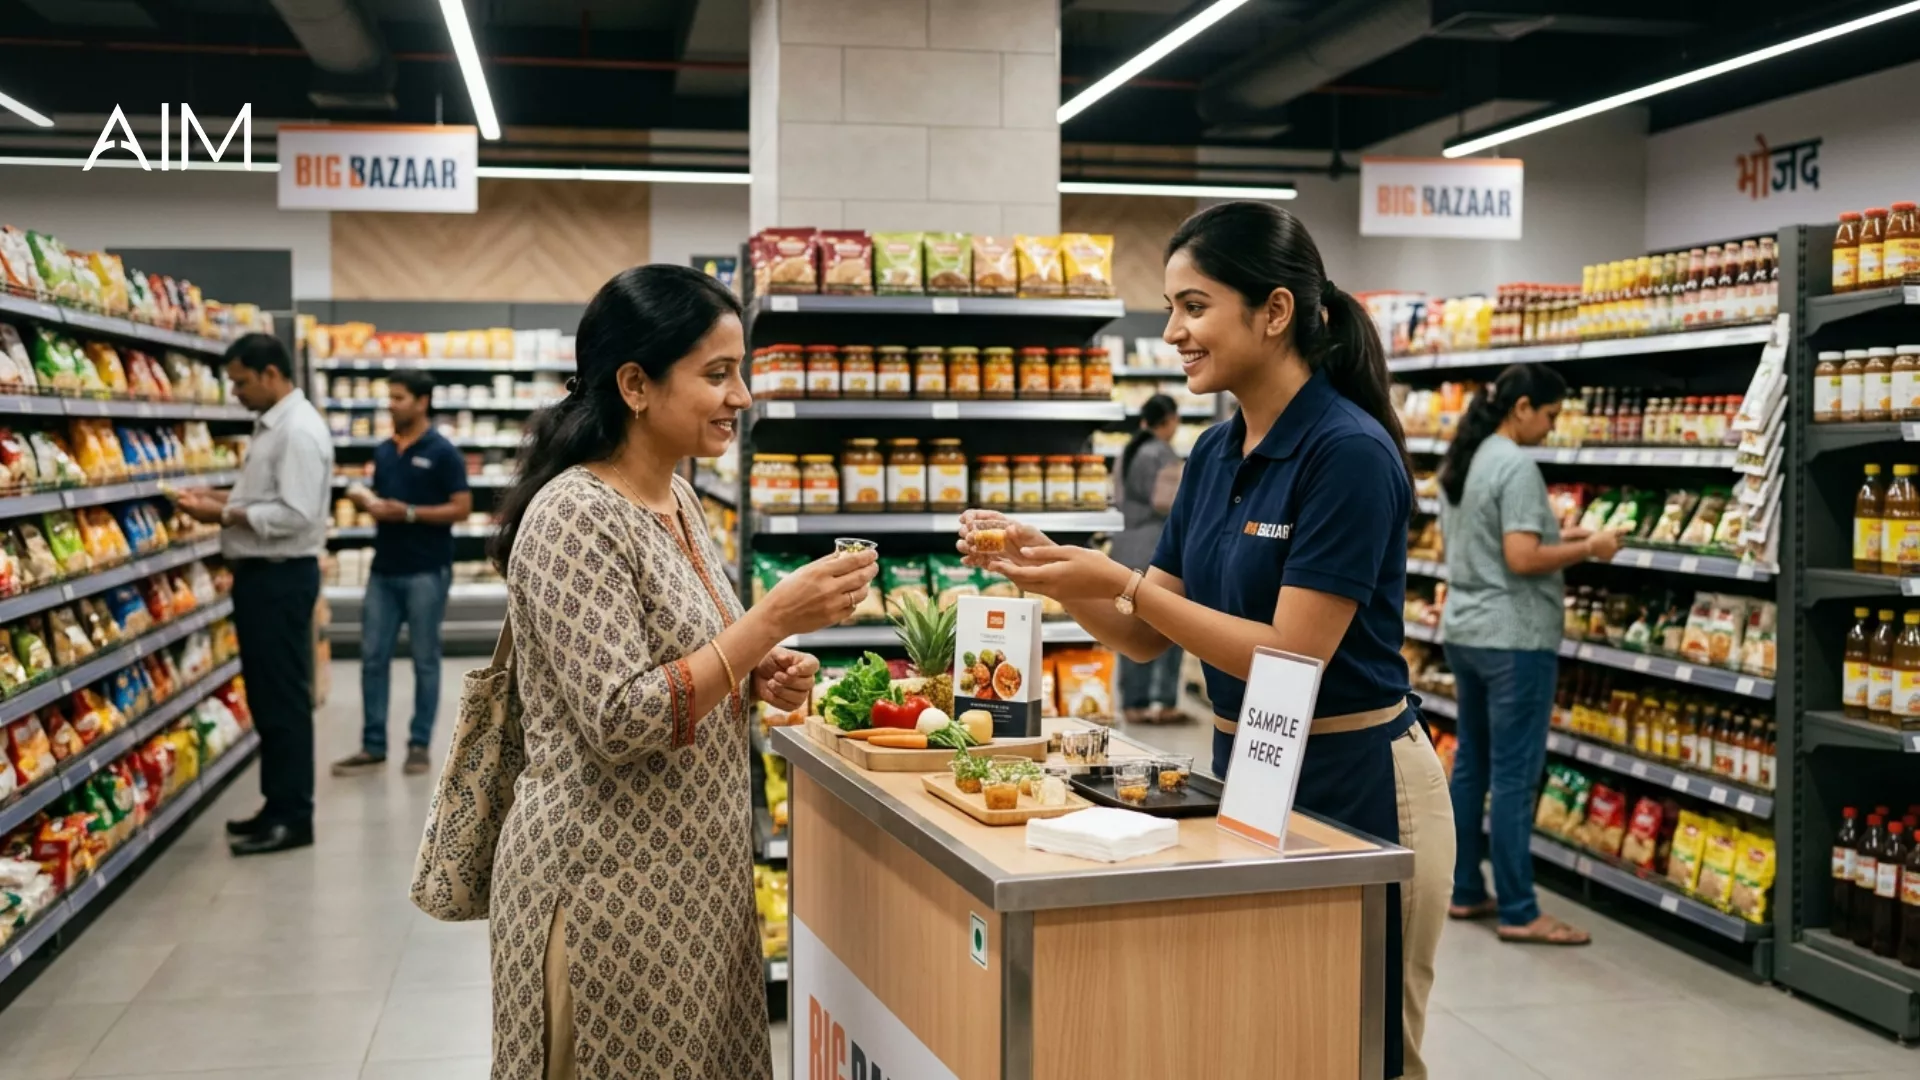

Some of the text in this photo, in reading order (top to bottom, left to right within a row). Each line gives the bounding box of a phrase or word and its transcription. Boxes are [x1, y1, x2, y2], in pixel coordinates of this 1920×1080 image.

[295, 154, 457, 189] BIG BAZAAR
[1376, 184, 1511, 218] BIG BAZAAR
[1247, 707, 1299, 739] SAMPLE
[1247, 740, 1284, 768] HERE
